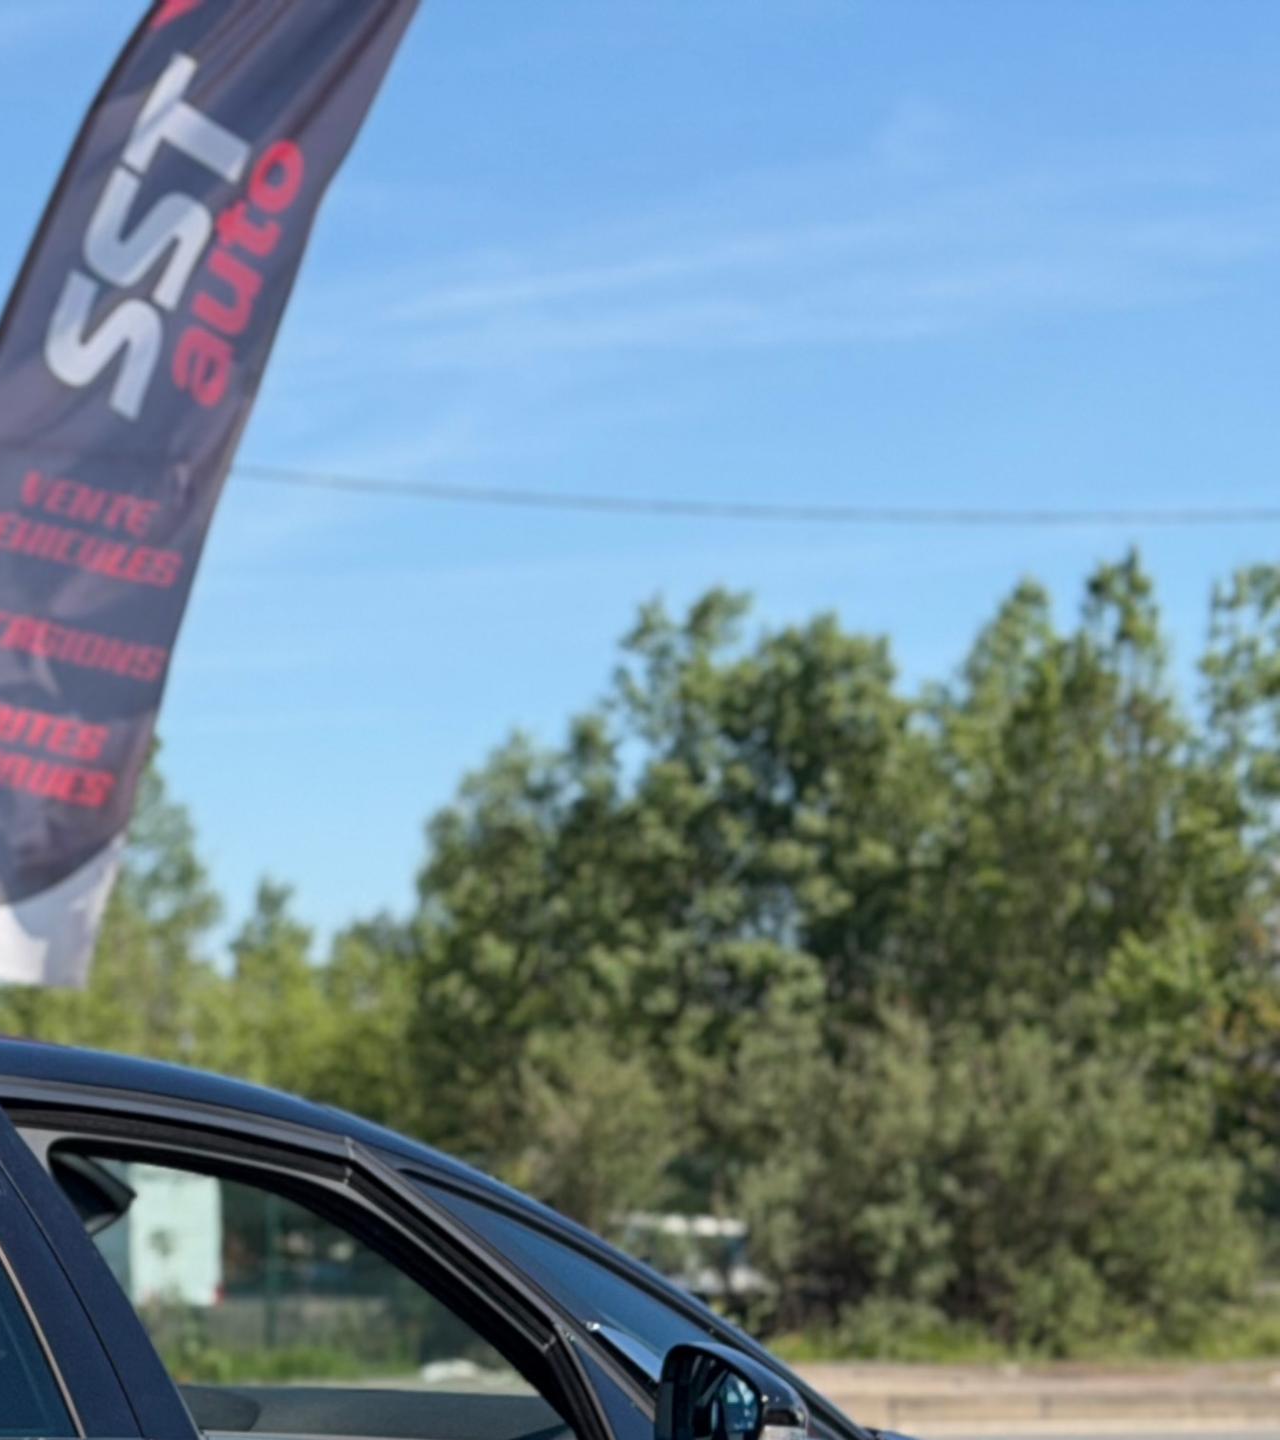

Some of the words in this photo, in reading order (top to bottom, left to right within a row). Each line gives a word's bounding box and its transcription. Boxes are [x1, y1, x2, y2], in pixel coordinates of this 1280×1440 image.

[43, 52, 252, 422] SST
[172, 139, 304, 408] auto
[21, 469, 161, 537] VENTE
